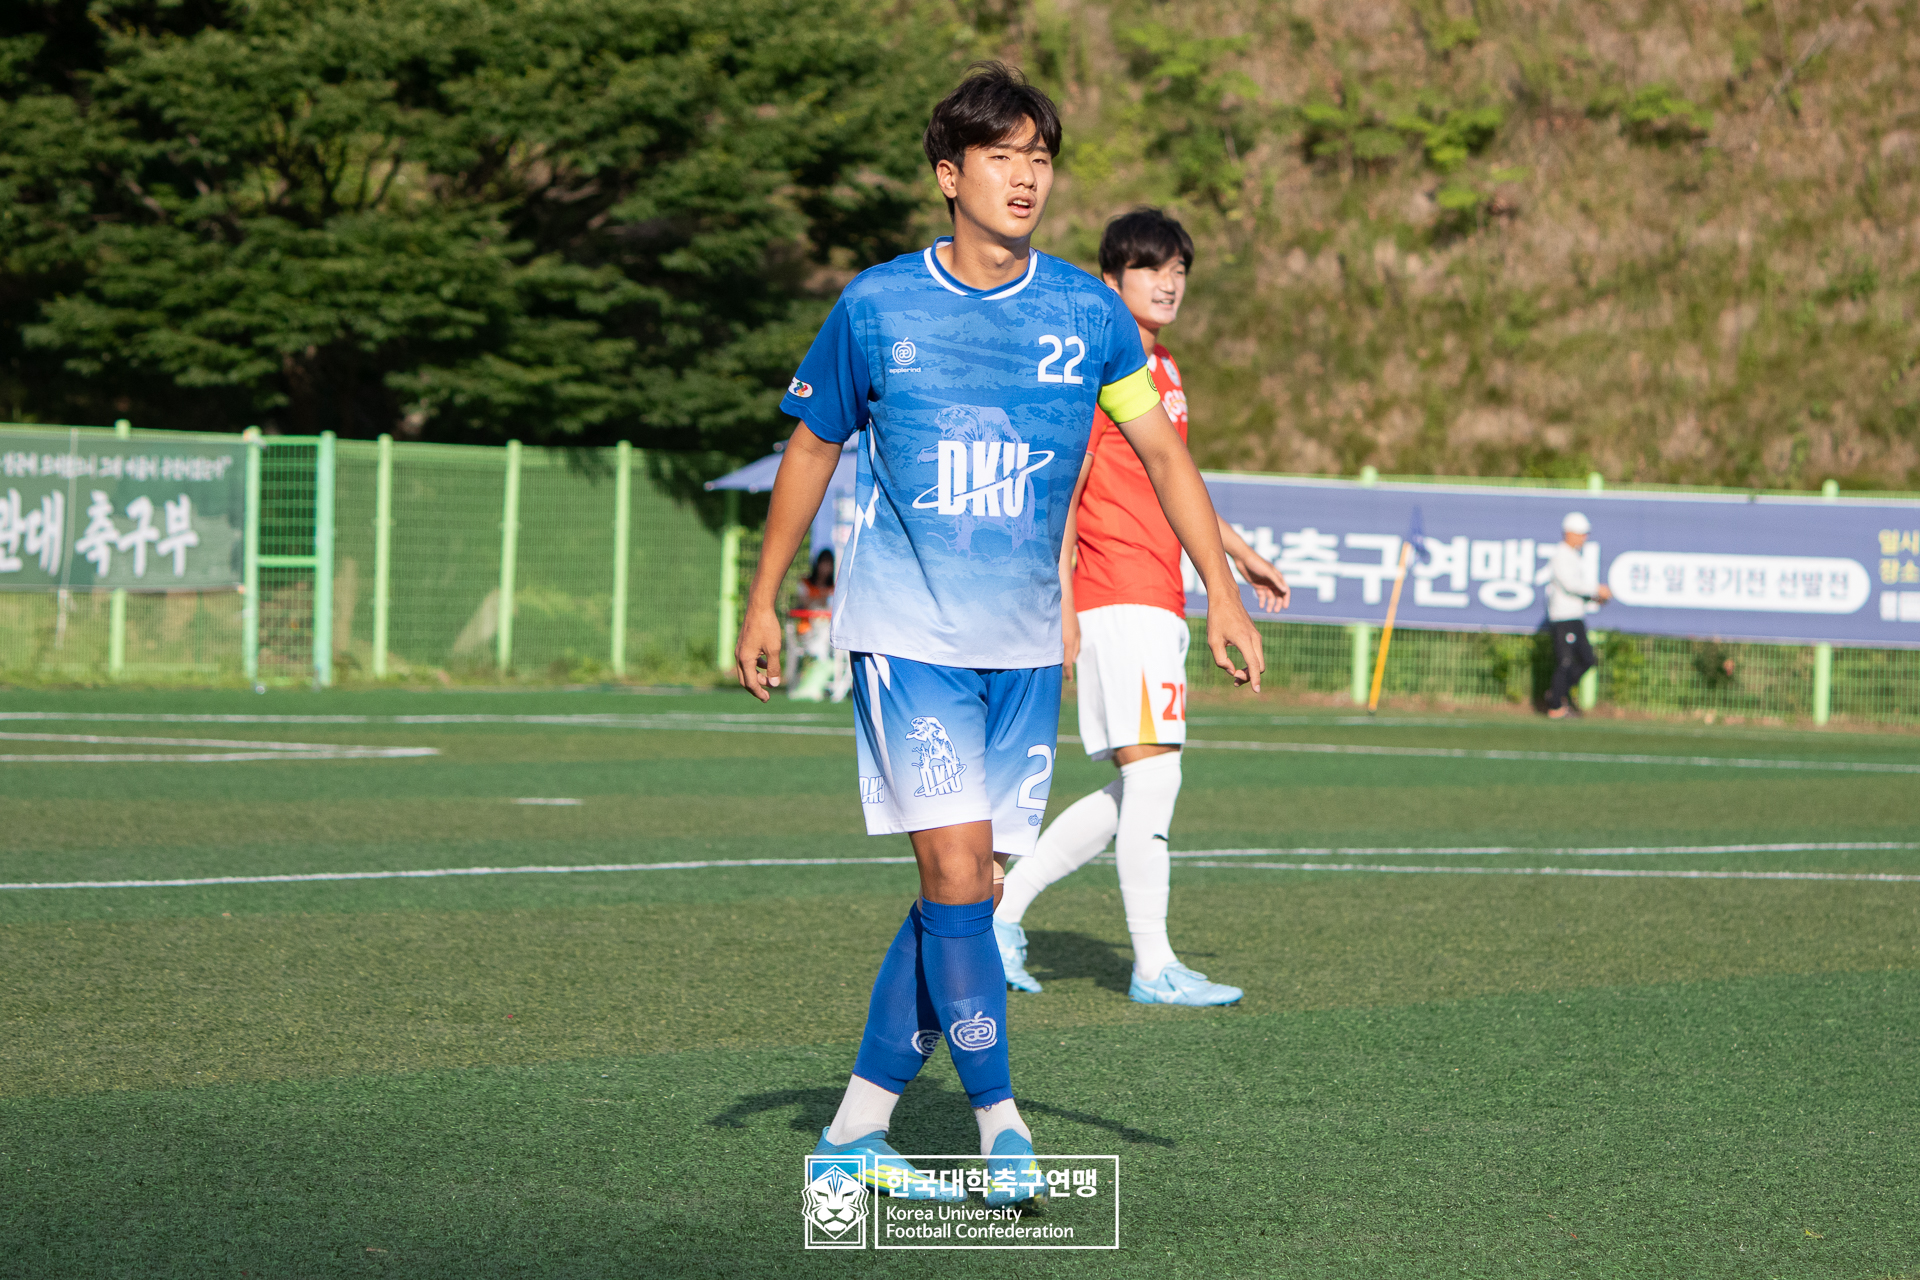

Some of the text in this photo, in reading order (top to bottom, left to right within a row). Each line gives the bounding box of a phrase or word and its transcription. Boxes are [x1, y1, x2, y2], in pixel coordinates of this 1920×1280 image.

[888, 366, 922, 374] applerind
[1037, 334, 1086, 384] 22
[937, 440, 1030, 518] DKU
[75, 489, 199, 578] 축구부
[919, 762, 964, 798] DKU
